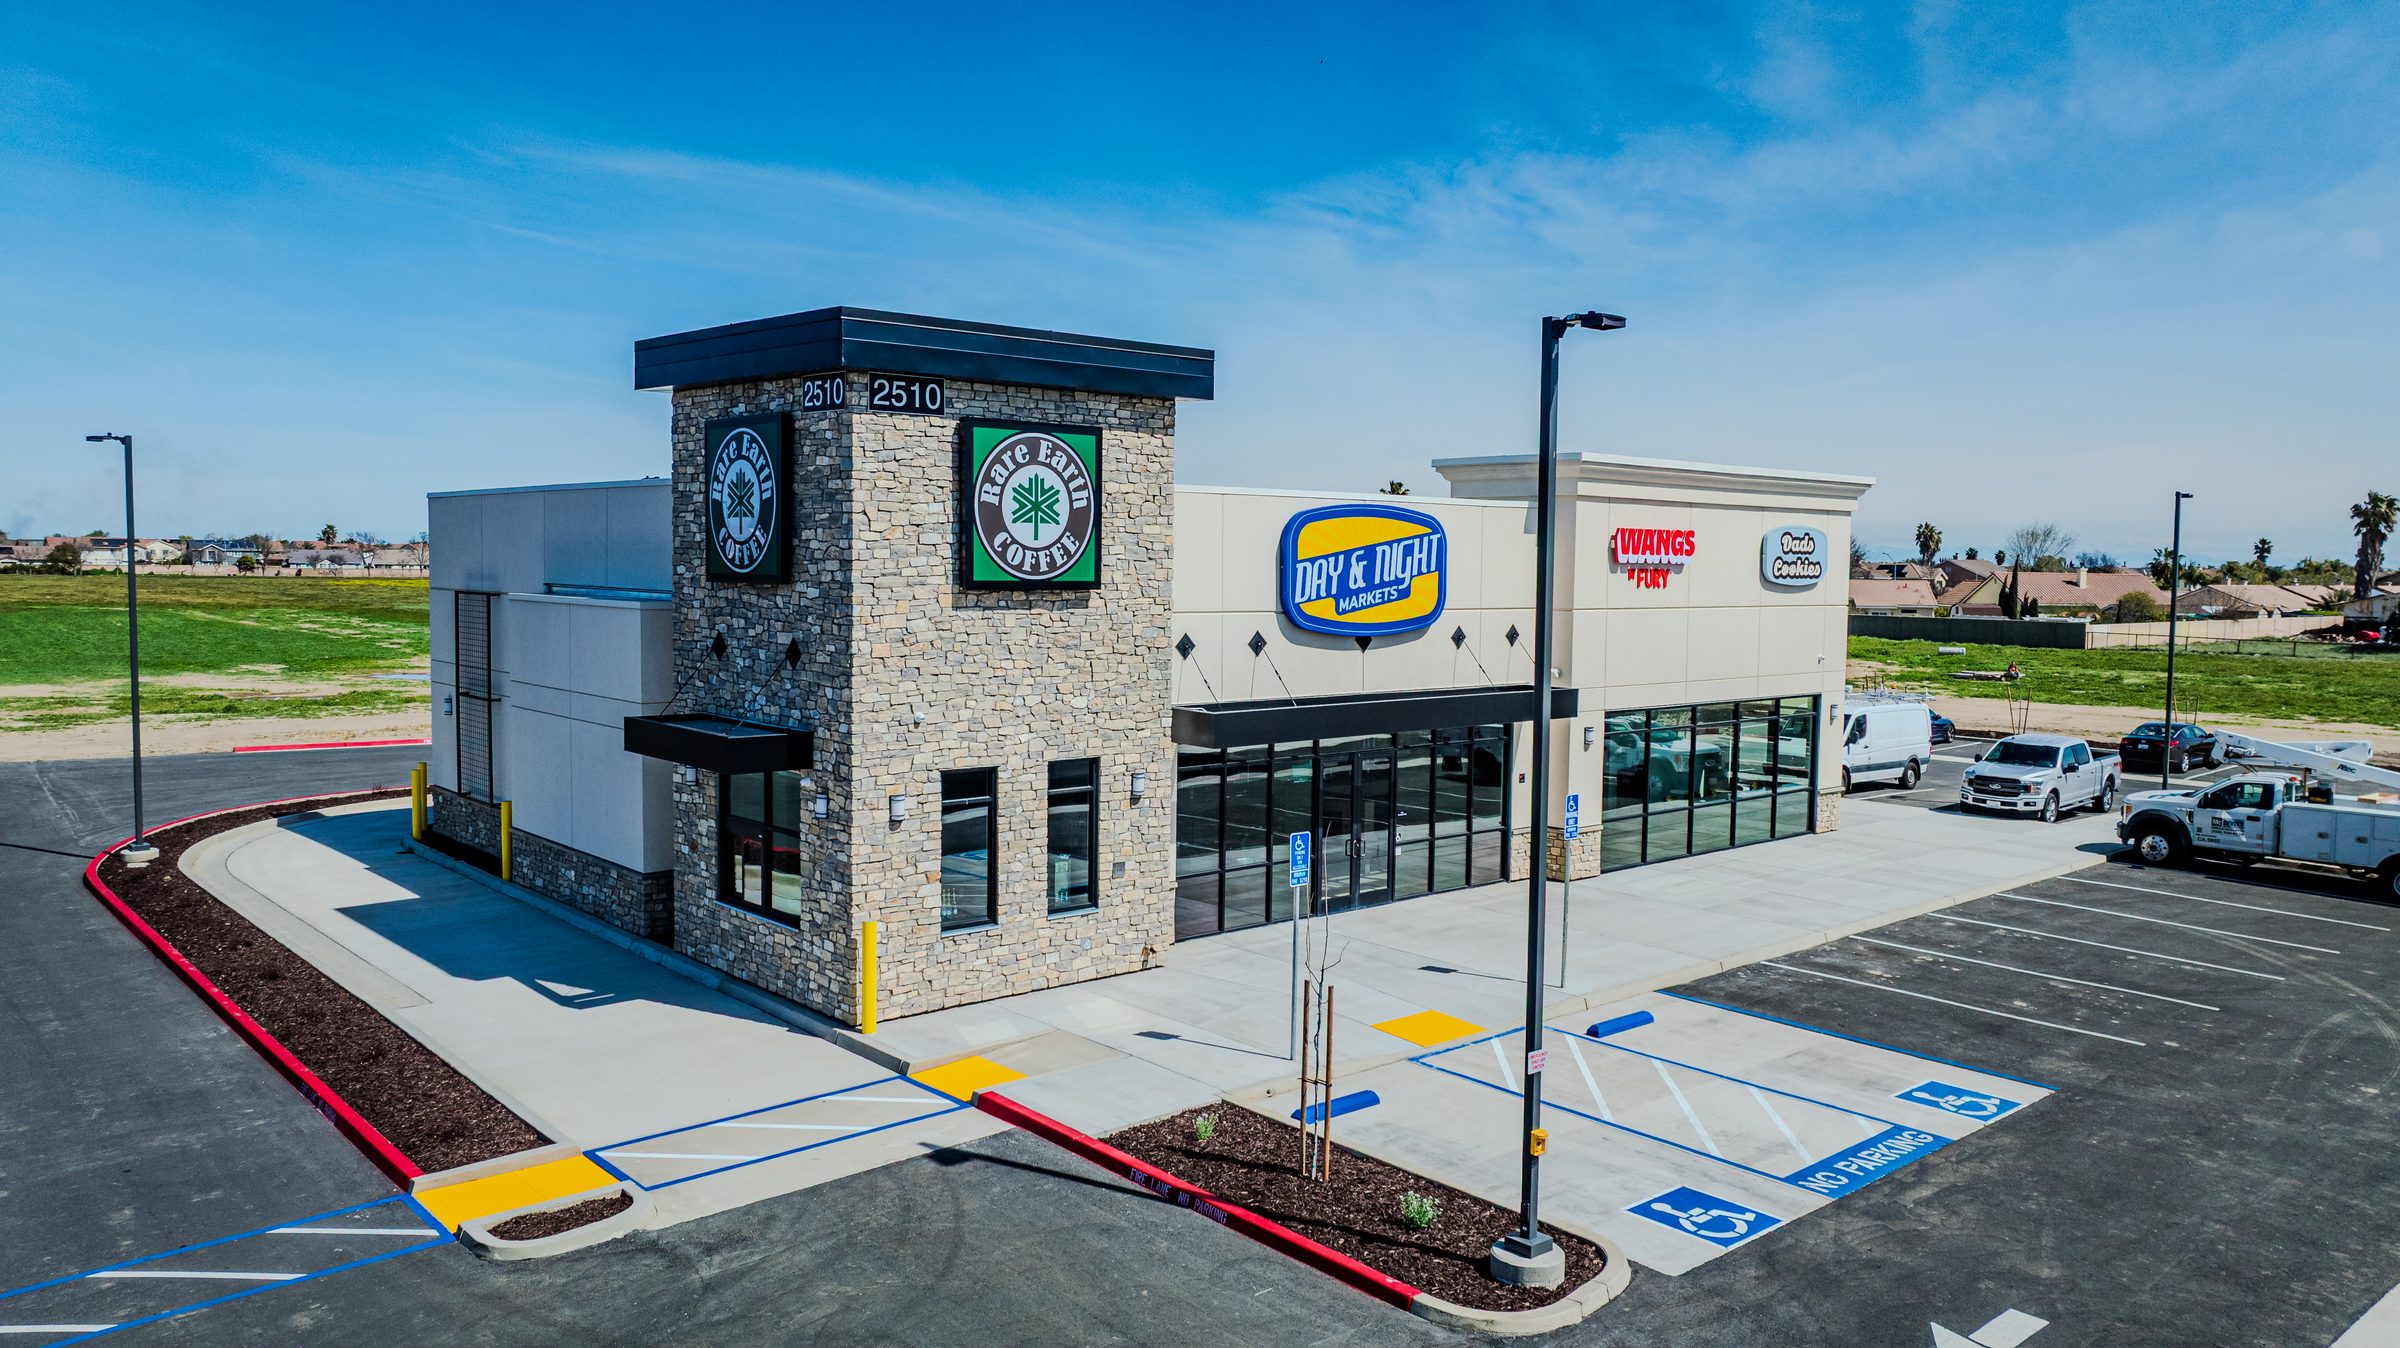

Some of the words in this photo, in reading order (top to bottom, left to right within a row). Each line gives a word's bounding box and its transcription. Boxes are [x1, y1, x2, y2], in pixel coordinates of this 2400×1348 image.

[804, 378, 844, 407] 2510
[873, 379, 941, 410] 2510
[712, 440, 737, 501] Rare
[741, 434, 772, 500] Earth
[980, 444, 1030, 506] Rare
[1037, 439, 1089, 510] Earth
[719, 525, 767, 565] COFFEE
[993, 531, 1080, 572] COFFEE
[1617, 527, 1696, 558] WANGS
[1781, 533, 1815, 553] Dads
[1295, 554, 1344, 604] DAY
[1349, 549, 1367, 590] &
[1375, 533, 1441, 590] NIGHT
[1637, 568, 1670, 589] FURY
[1773, 558, 1821, 578] Cookies
[1339, 585, 1398, 613] MARKETS
[1797, 1171, 1849, 1193] NO
[1833, 1130, 1934, 1176] PARKING
[1130, 1168, 1148, 1187] FIRE
[1150, 1178, 1171, 1197] LANE
[1177, 1191, 1190, 1206] NO
[1194, 1199, 1228, 1224] PARKING
